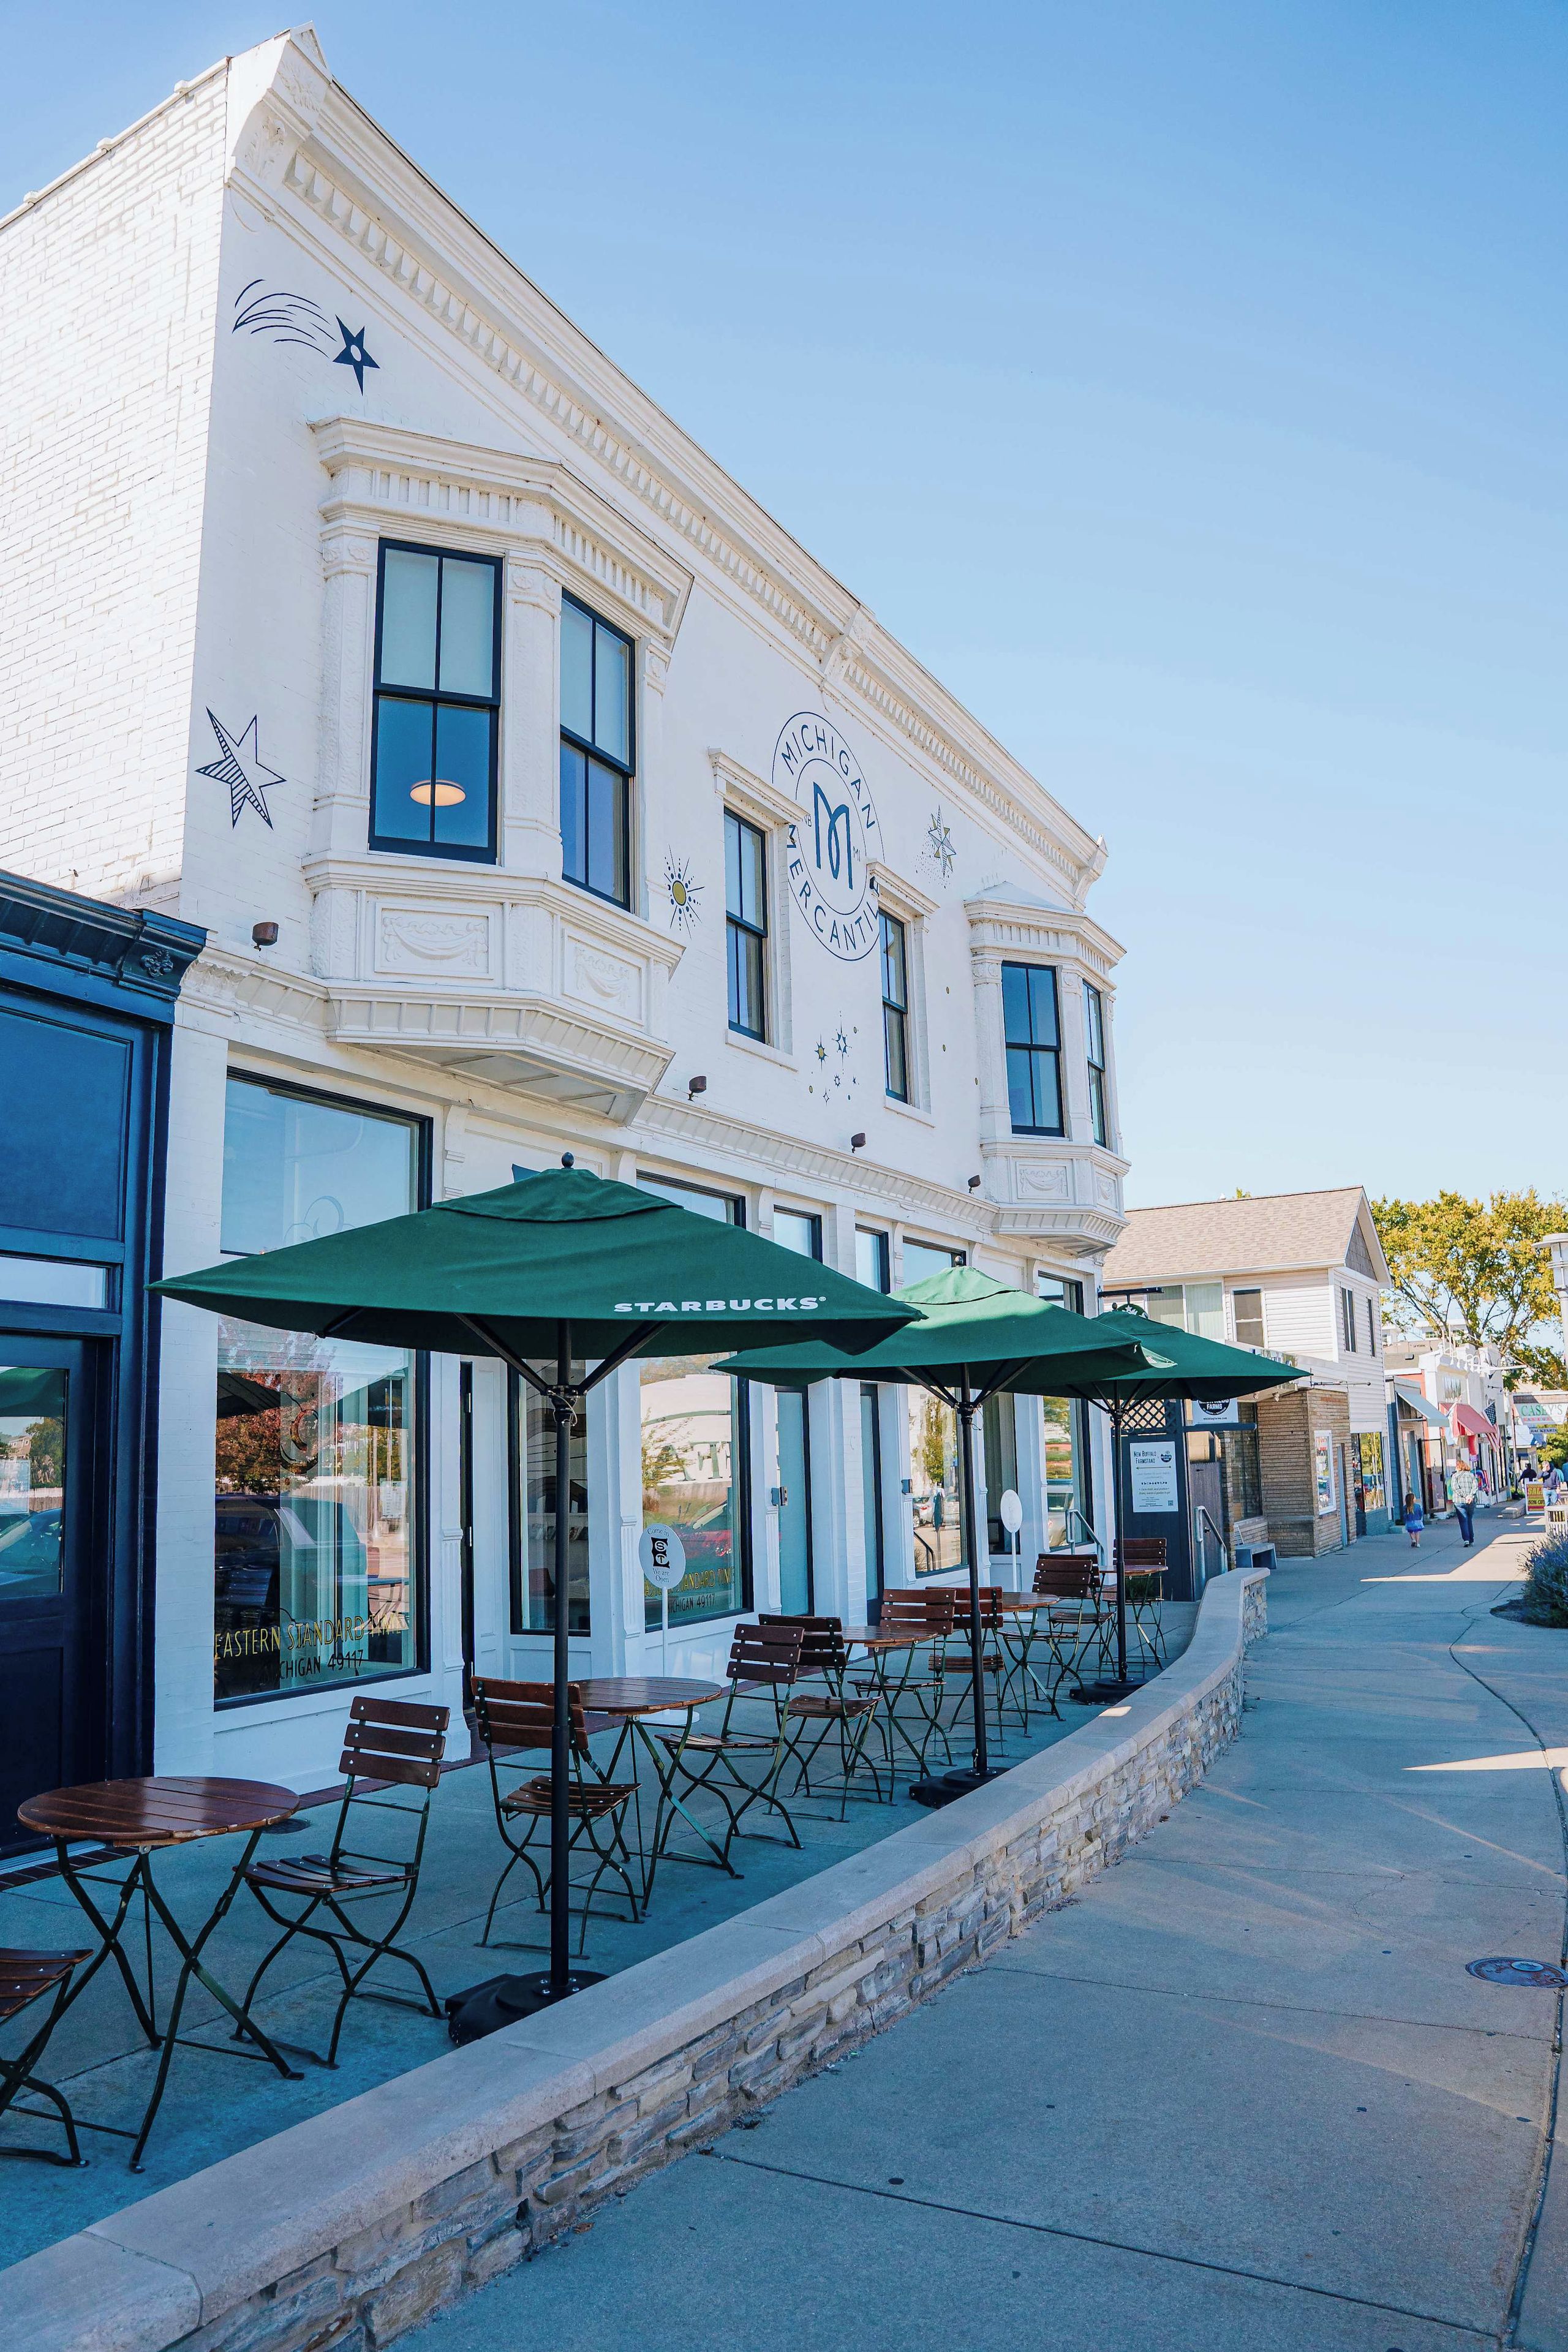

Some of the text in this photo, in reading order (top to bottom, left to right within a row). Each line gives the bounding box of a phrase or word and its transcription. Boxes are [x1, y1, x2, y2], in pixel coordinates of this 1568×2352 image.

[782, 725, 875, 829] MICHIGAN
[1520, 1404, 1563, 1416] CASEY'S
[655, 1575, 669, 1583] Open
[696, 1594, 715, 1608] 49117
[215, 1626, 281, 1659] EASTERN
[287, 1616, 364, 1651] STANDARD
[328, 1649, 364, 1672] 49117
